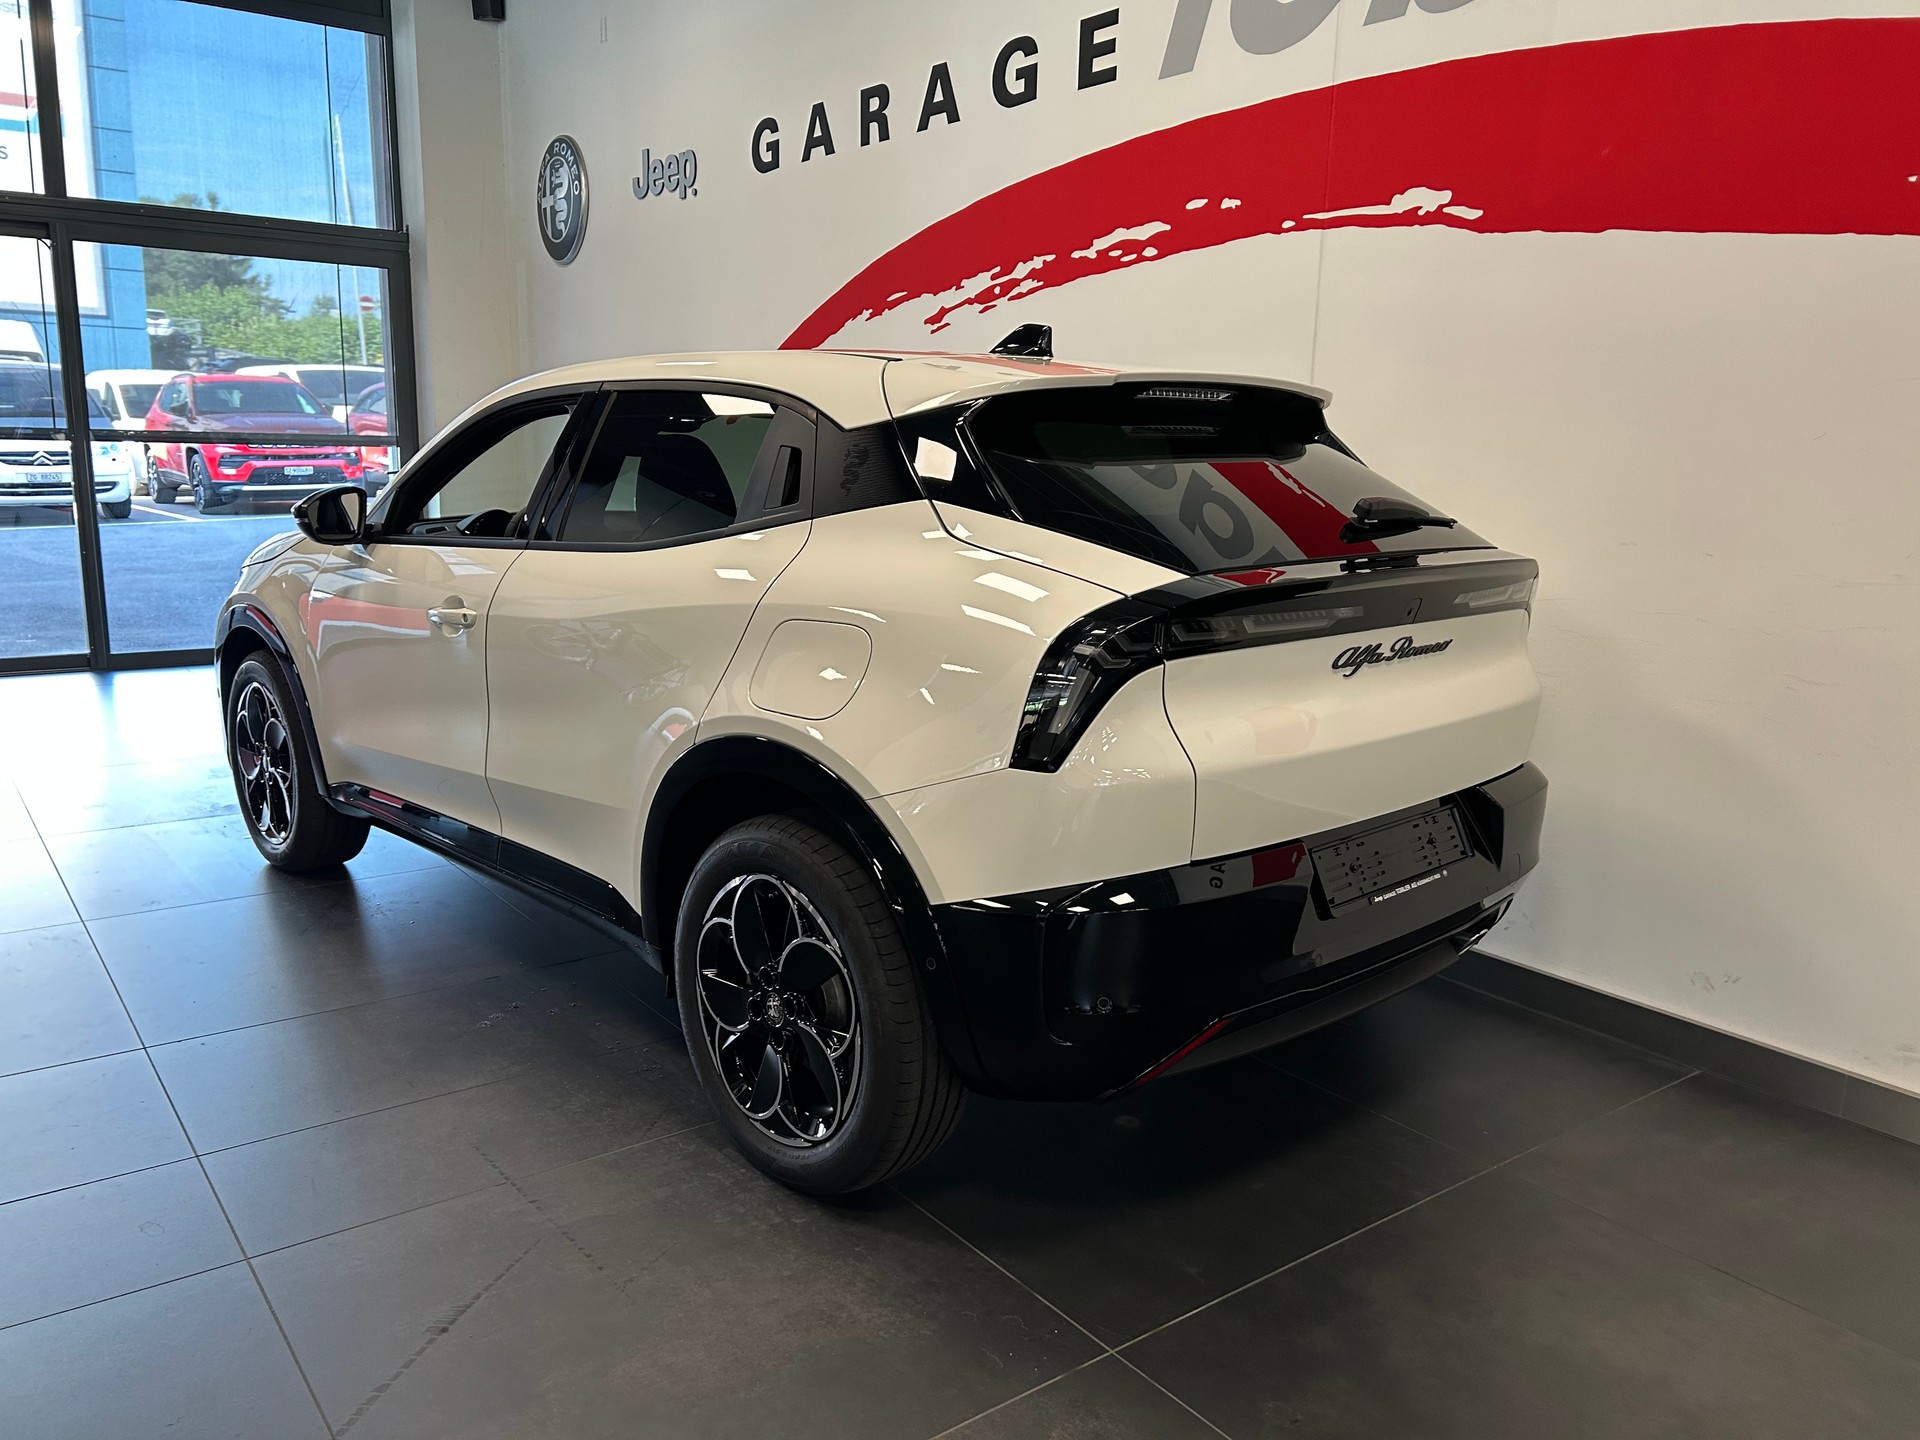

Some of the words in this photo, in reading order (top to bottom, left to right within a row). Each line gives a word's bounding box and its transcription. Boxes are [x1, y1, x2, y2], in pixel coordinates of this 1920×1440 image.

[751, 7, 1120, 174] GARAGE
[553, 142, 581, 196] ROMEO
[1331, 642, 1387, 678] Alfa
[1385, 635, 1454, 662] Romeo
